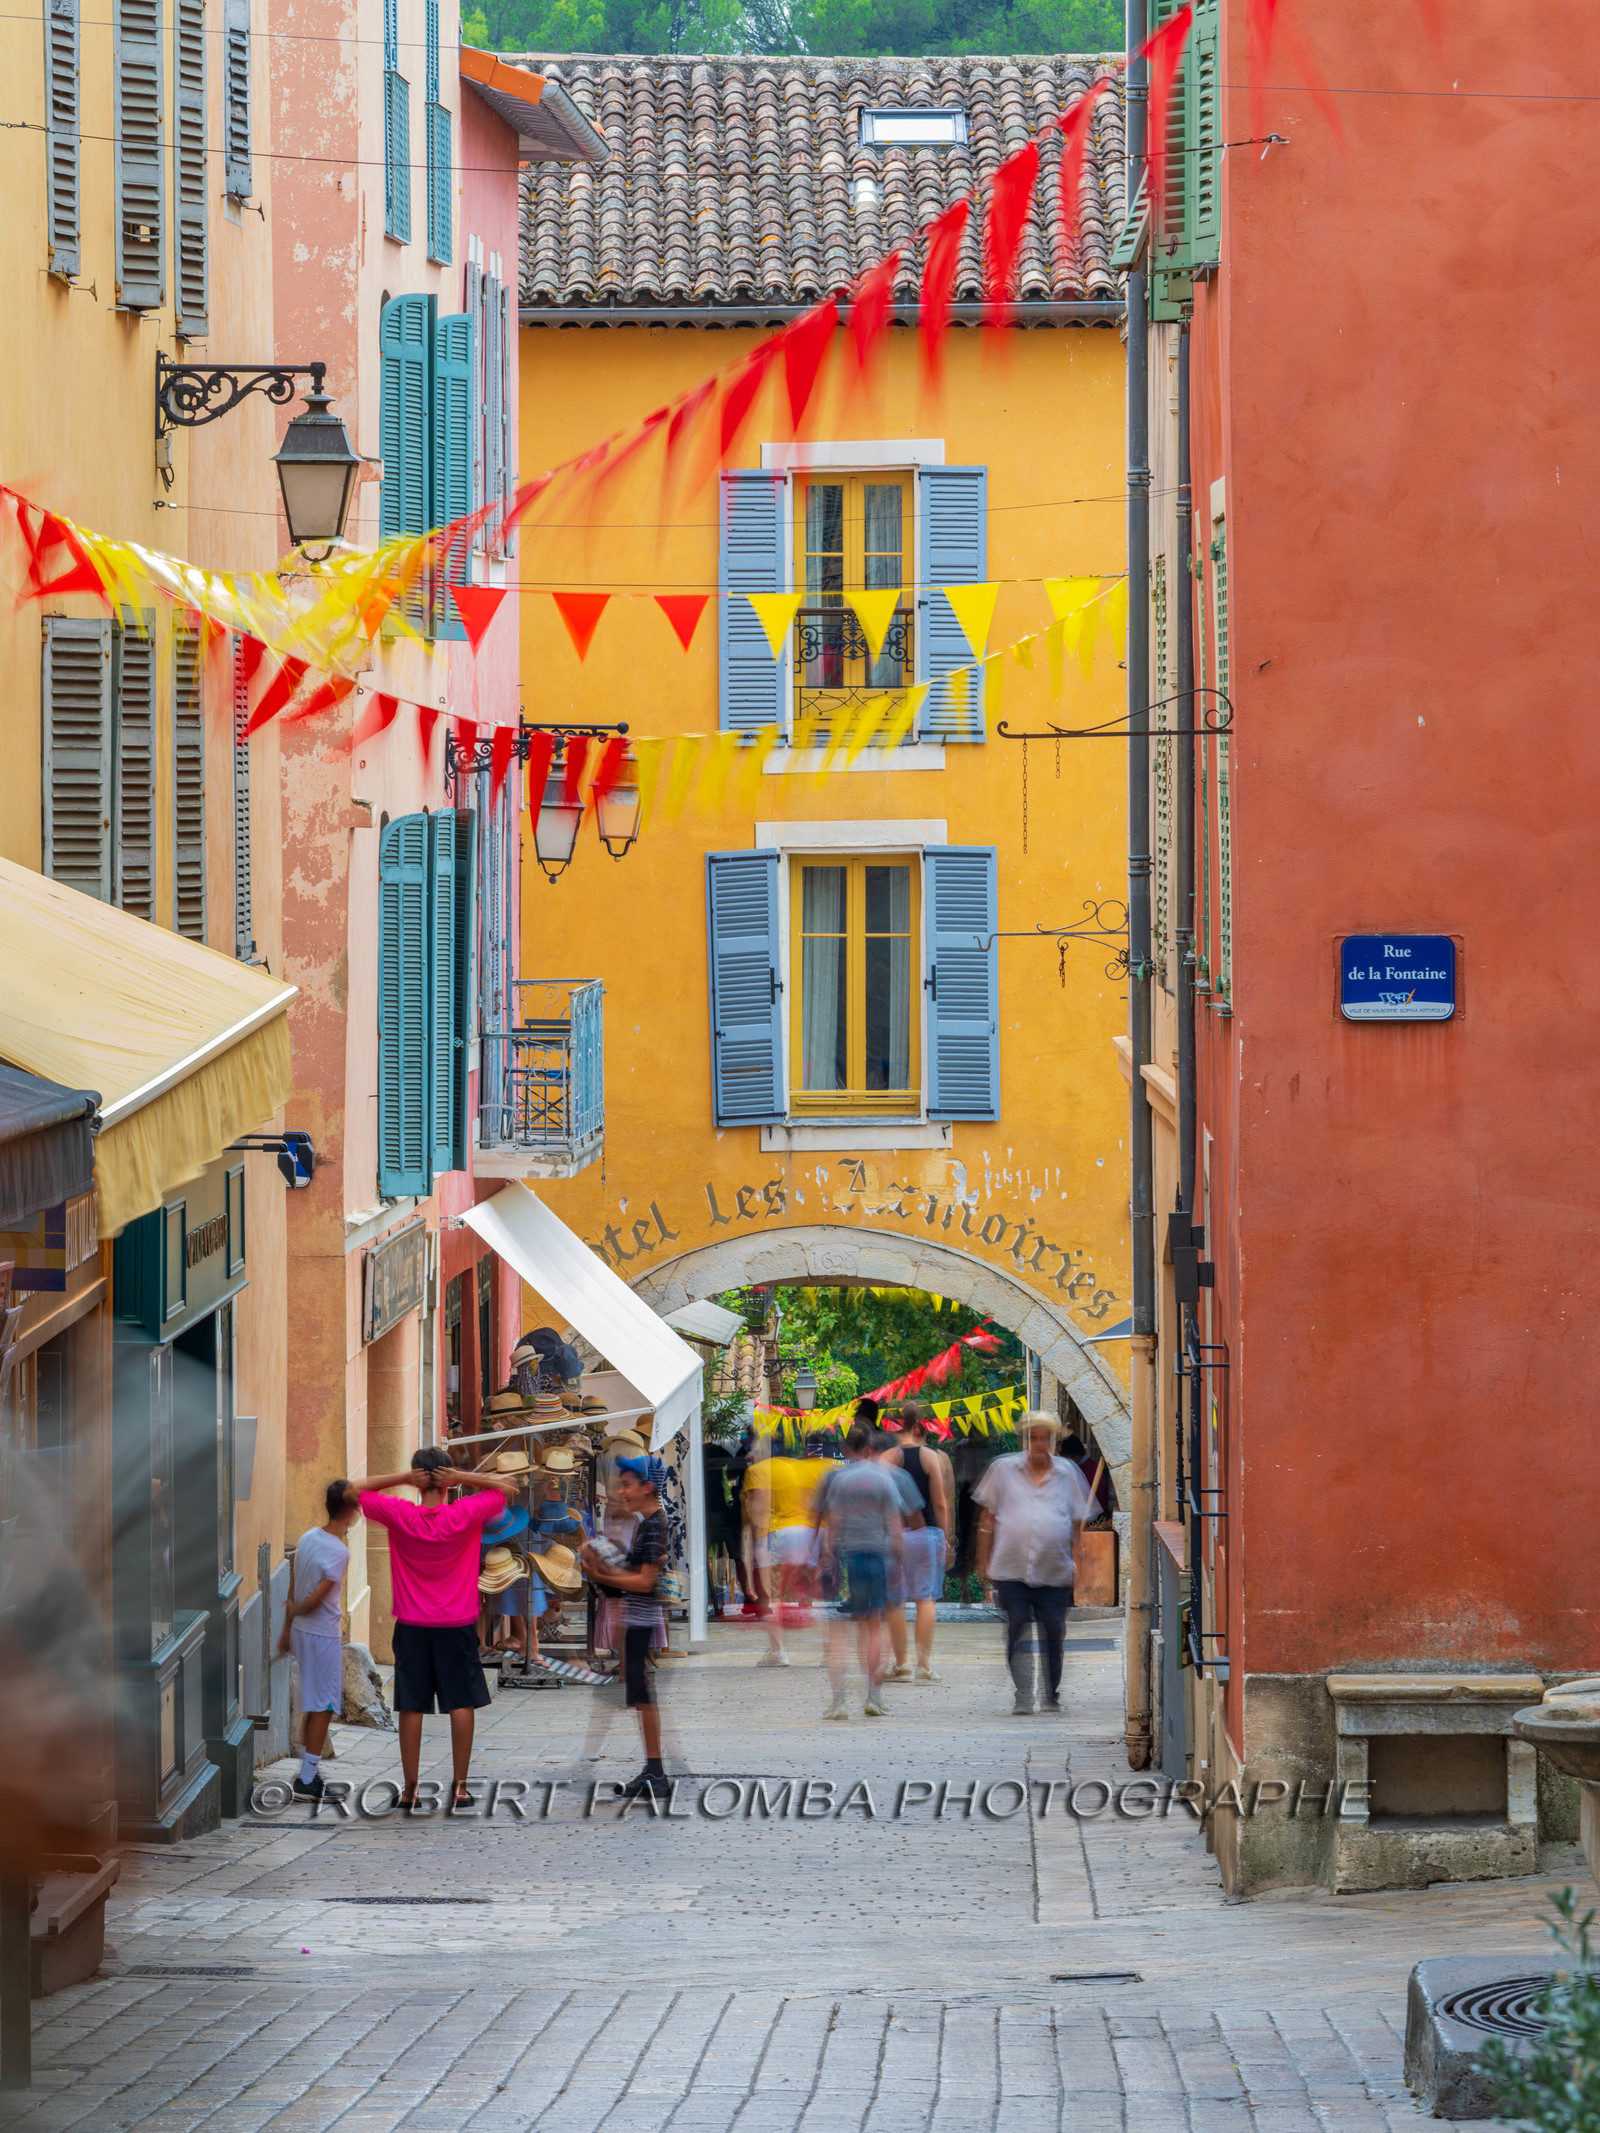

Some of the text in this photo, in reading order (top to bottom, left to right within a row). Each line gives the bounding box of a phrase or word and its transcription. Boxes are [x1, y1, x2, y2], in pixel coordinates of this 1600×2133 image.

[1383, 944, 1412, 958] Rue
[1348, 966, 1447, 980] de la Fontaine
[582, 1200, 681, 1267] ôtel
